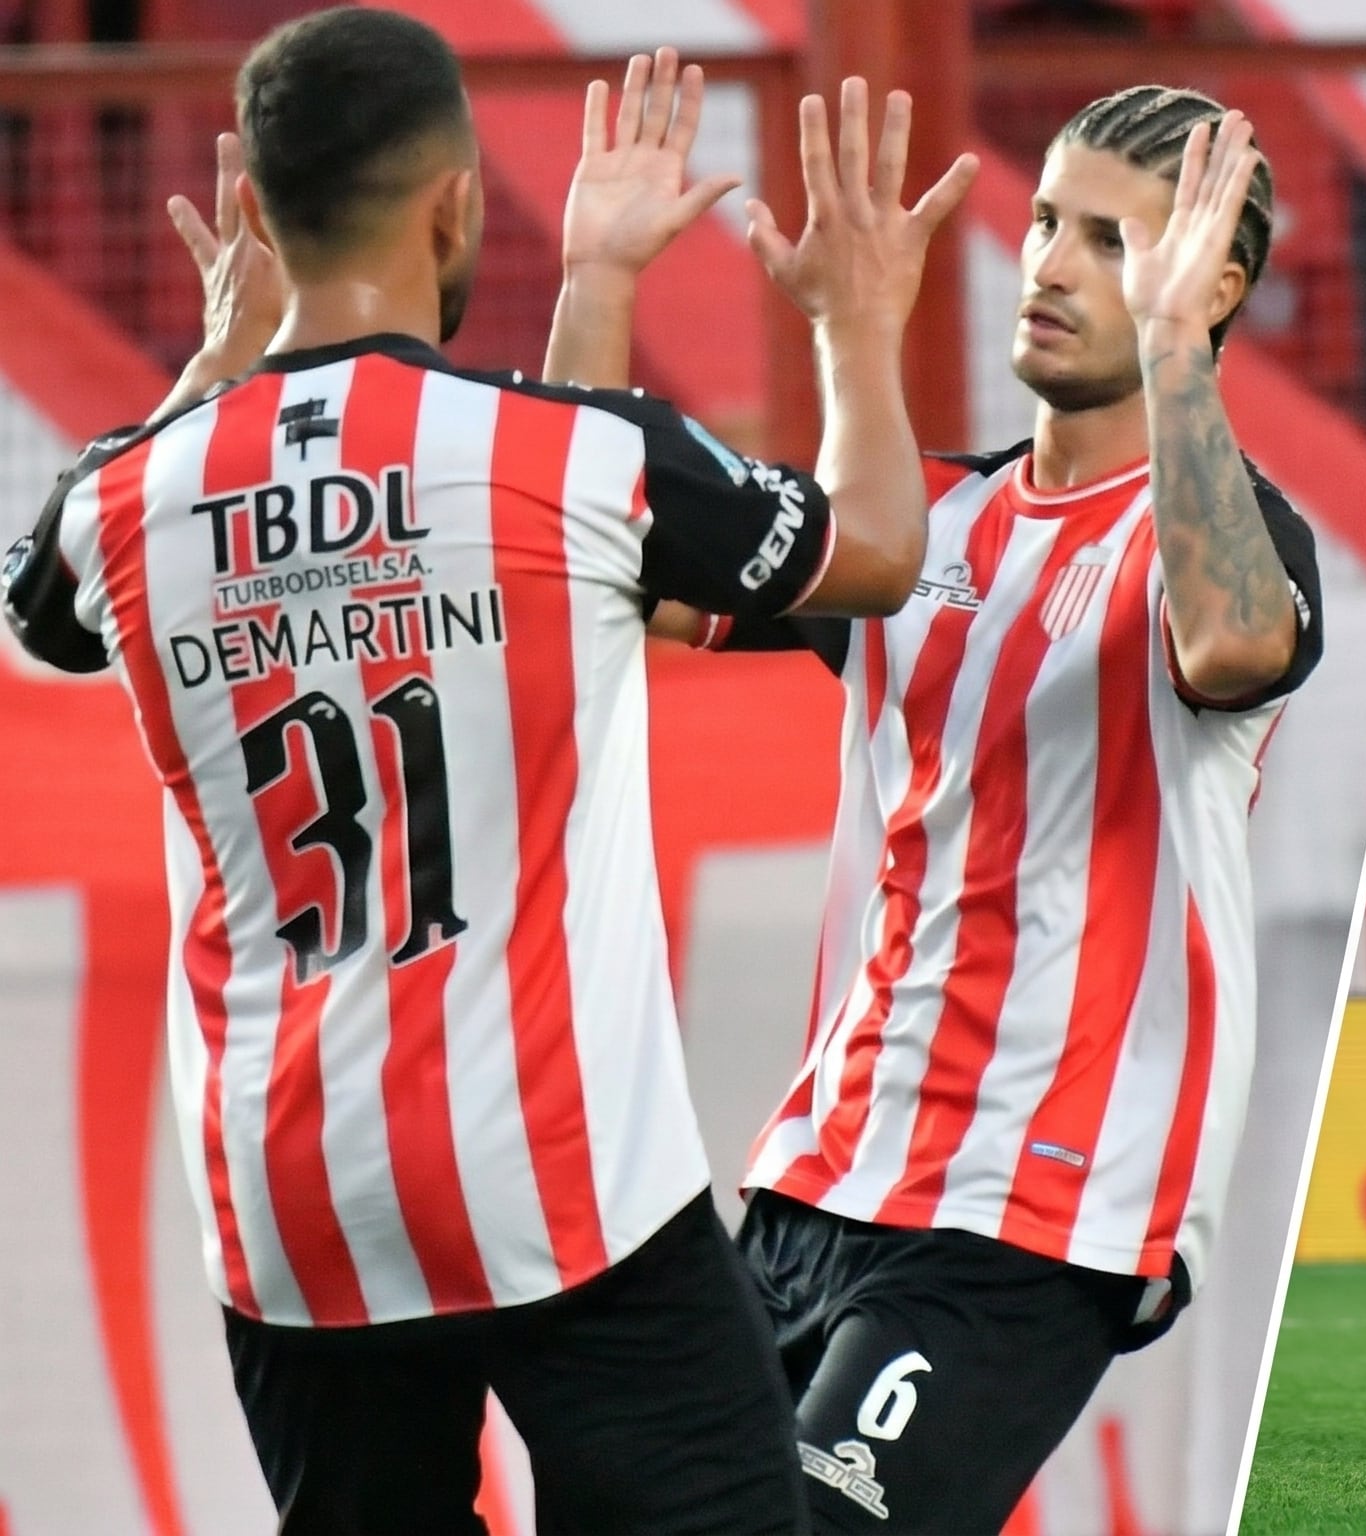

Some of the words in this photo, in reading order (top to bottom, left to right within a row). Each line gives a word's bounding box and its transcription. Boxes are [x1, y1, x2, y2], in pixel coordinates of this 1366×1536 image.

[191, 470, 432, 574] TBDL
[218, 560, 379, 610] TURBODISEL
[170, 589, 503, 689] DEMARTINI
[239, 677, 468, 984] 31
[857, 1350, 934, 1441] 6
